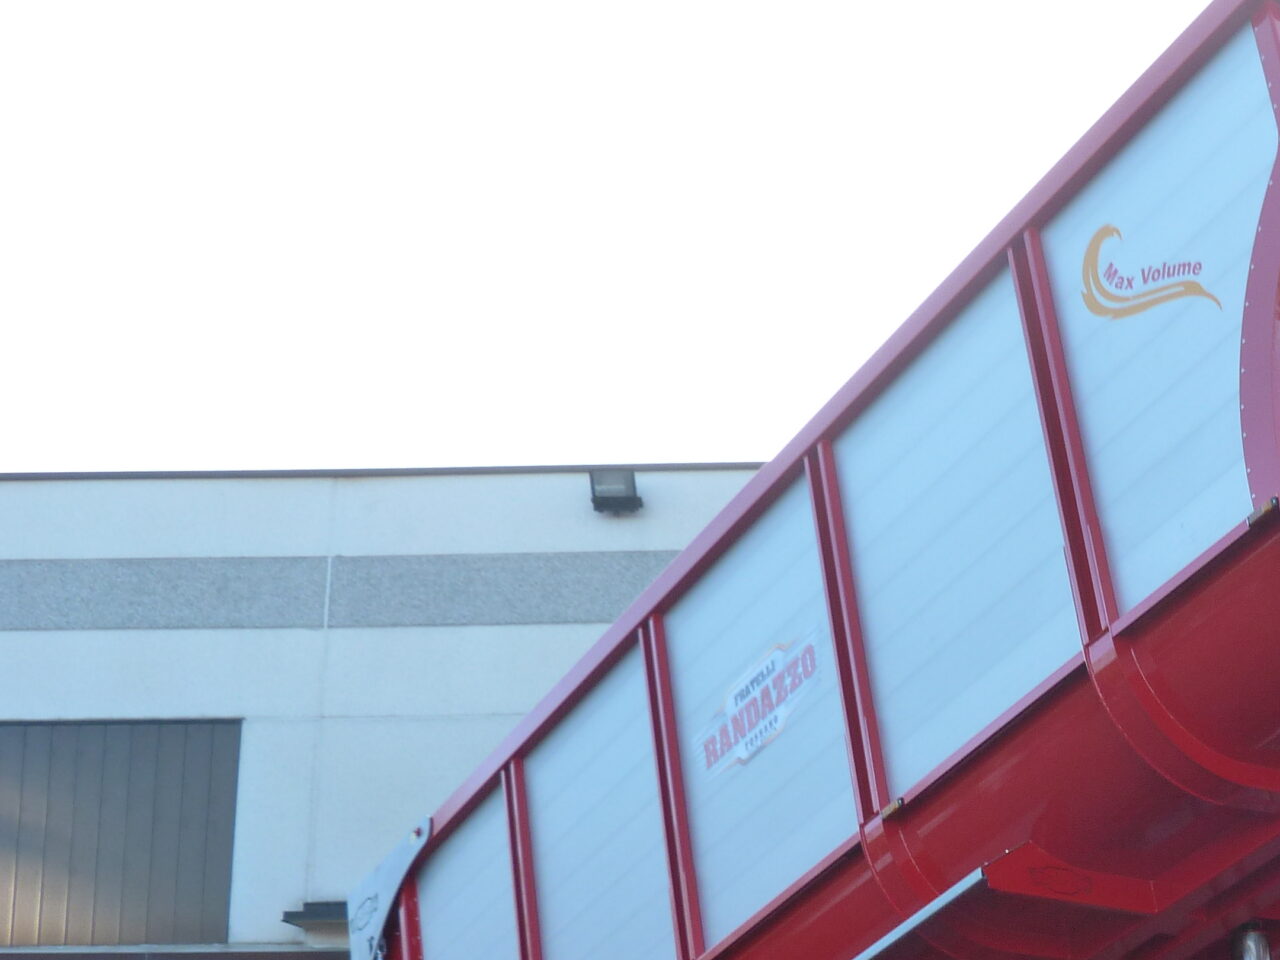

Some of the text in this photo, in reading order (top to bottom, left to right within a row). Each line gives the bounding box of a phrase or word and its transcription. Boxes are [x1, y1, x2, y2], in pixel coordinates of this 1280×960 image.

[1103, 260, 1203, 291] Max Volume
[703, 643, 817, 770] RANDAZZO
